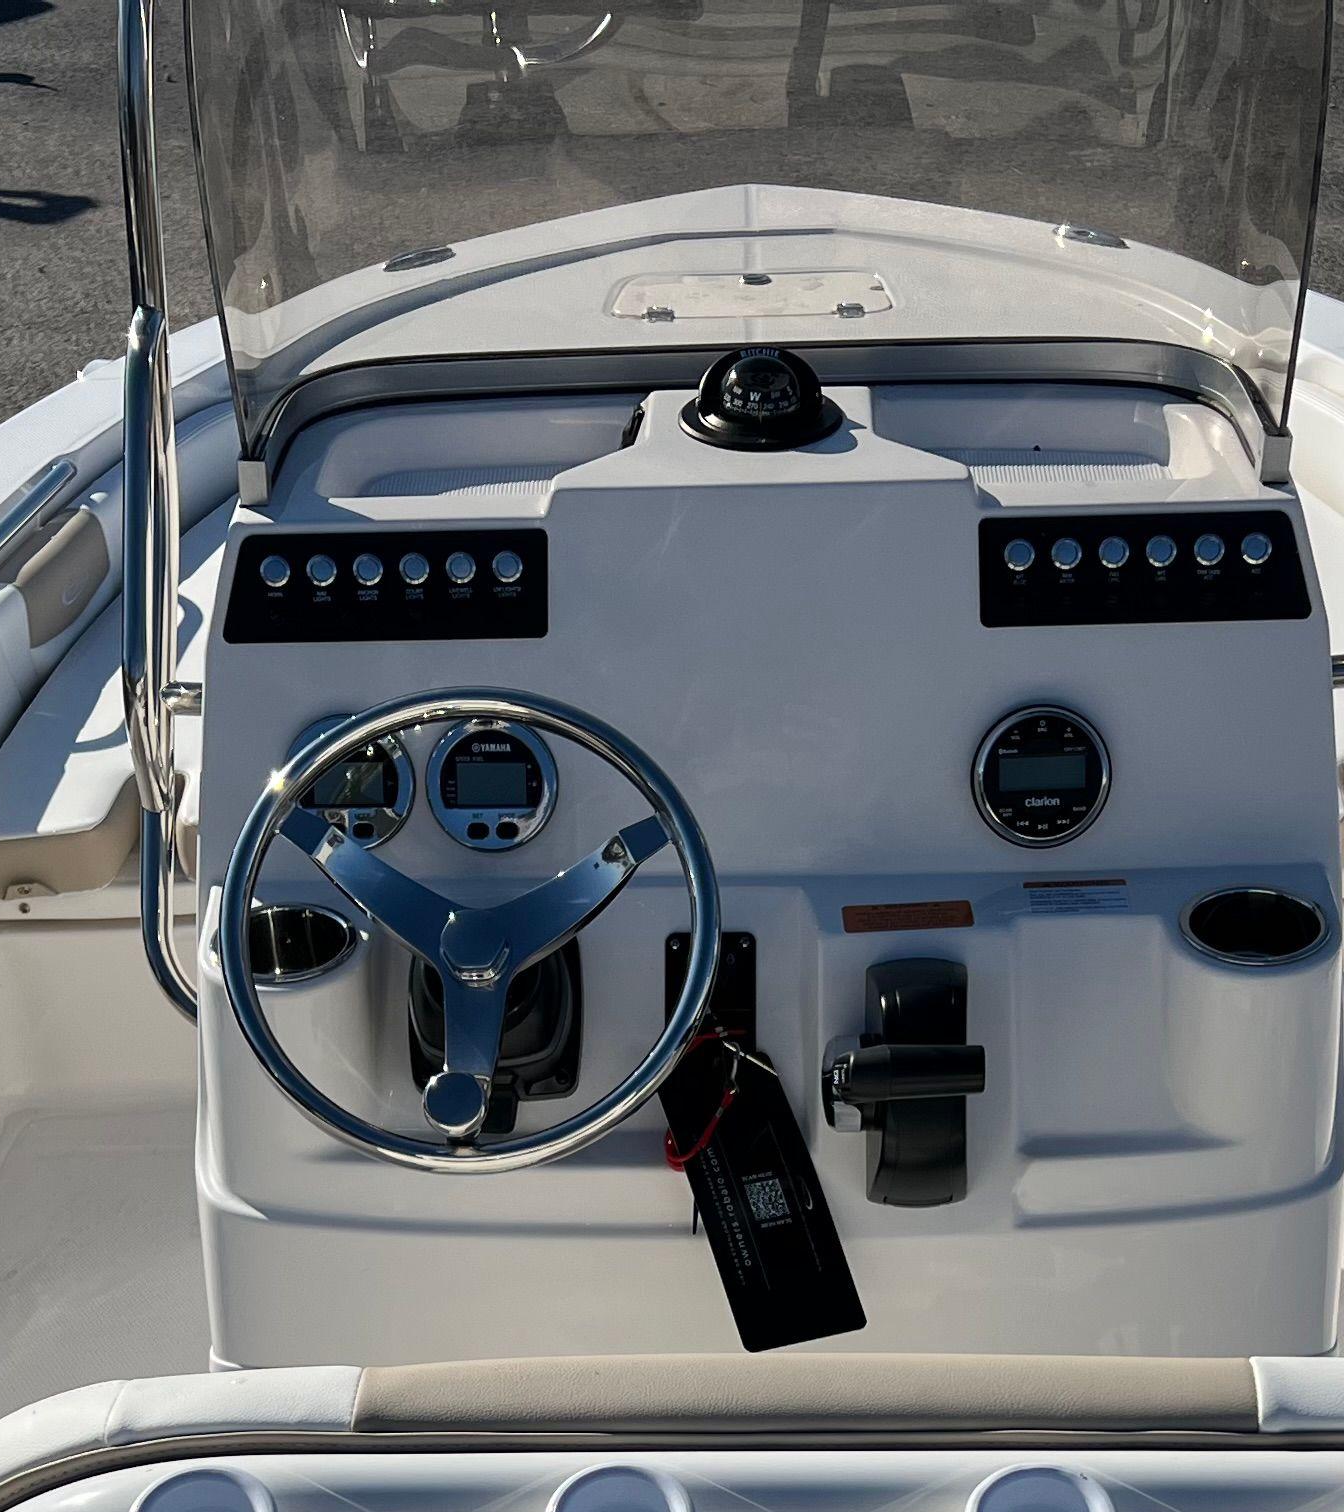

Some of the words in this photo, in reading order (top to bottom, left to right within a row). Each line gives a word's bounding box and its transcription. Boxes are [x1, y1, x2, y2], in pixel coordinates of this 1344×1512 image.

[740, 348, 780, 359] RITCHIE
[750, 391, 761, 402] W
[481, 743, 511, 752] YAMAHA
[1025, 797, 1060, 807] clarion
